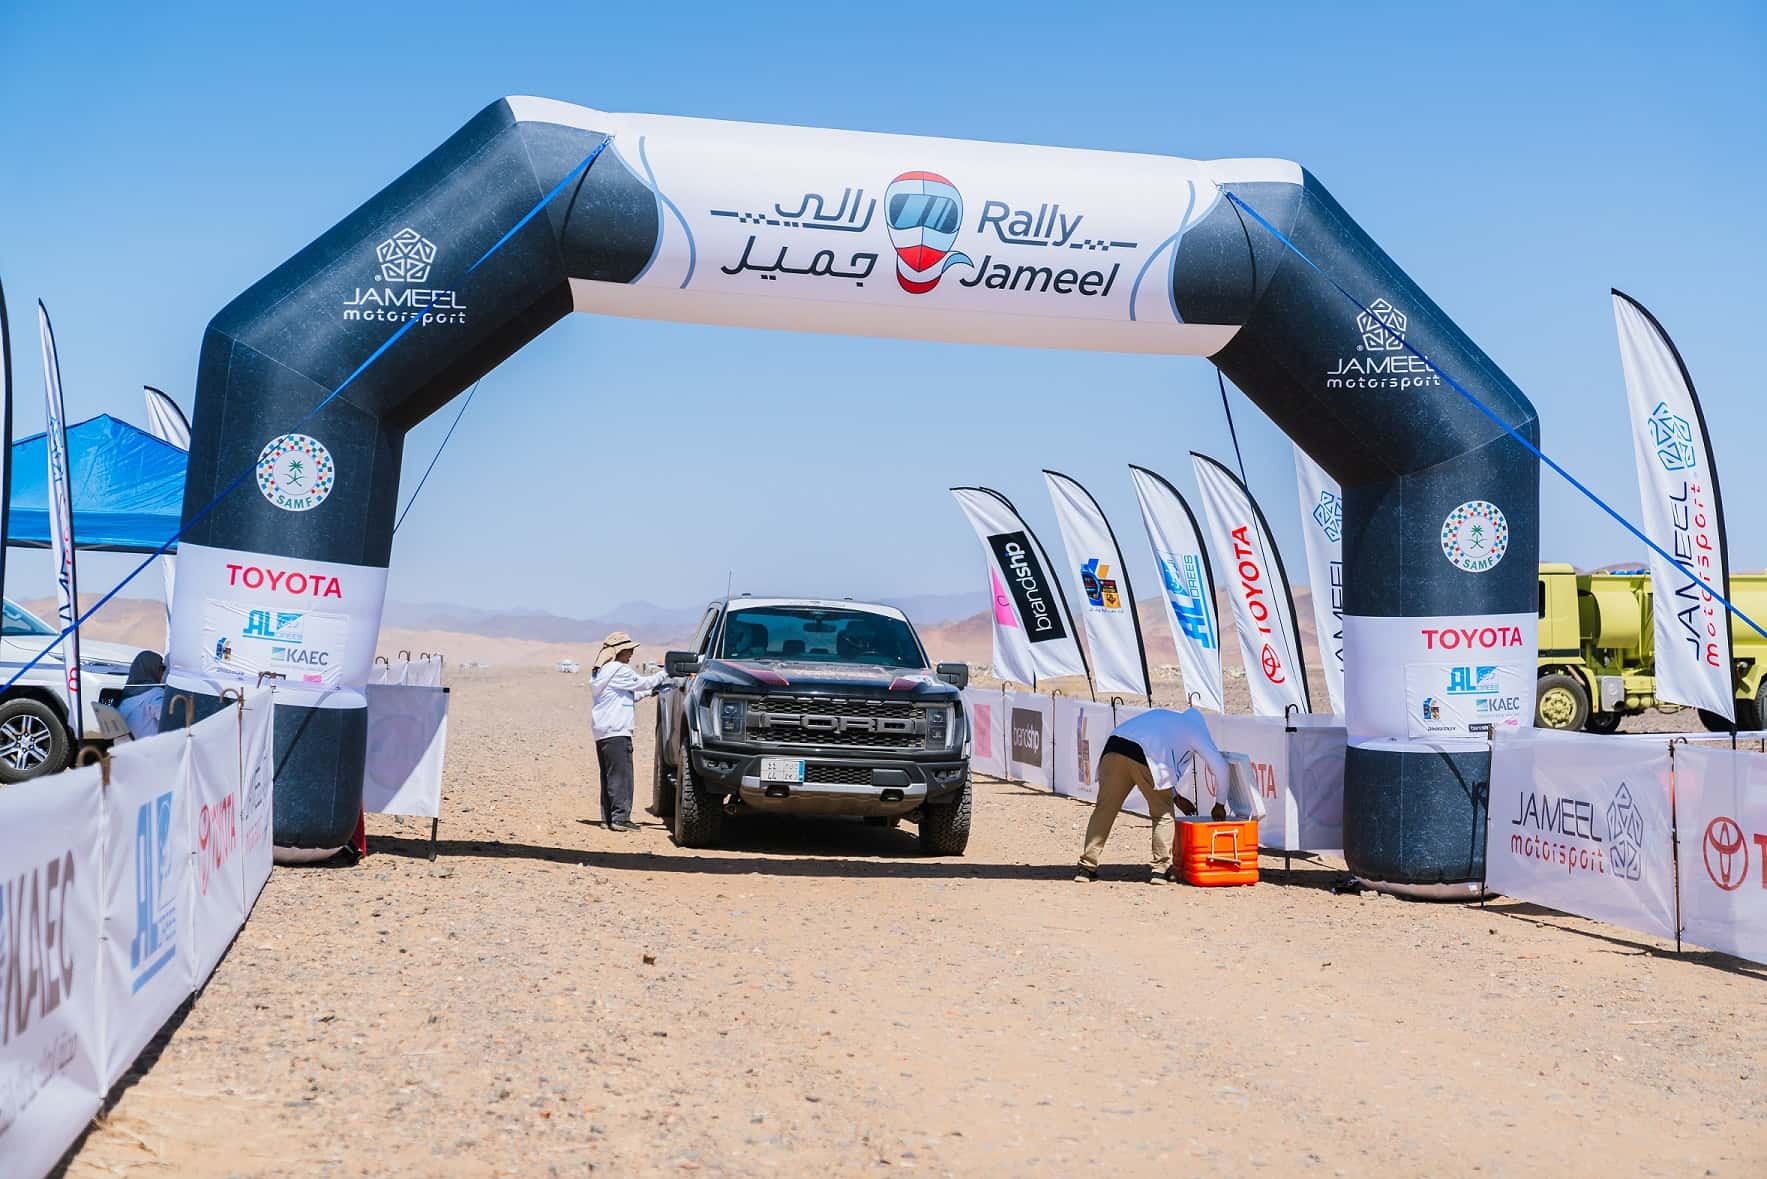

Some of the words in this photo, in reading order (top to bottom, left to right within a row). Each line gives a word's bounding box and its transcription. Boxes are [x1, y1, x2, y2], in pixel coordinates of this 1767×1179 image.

[977, 200, 1083, 248] Rally
[720, 235, 879, 288] جميل
[958, 255, 1121, 297] Jameel
[343, 288, 467, 309] JAMEEL
[1327, 355, 1437, 375] JAMEEL
[1327, 374, 1441, 391] motorsport
[275, 493, 314, 511] SAMF
[1462, 557, 1495, 571] SAMF
[226, 564, 343, 598] TOYOTA
[1421, 627, 1523, 648] TOYOTA
[286, 648, 329, 666] KAEC
[1489, 697, 1520, 712] KAEC
[758, 712, 915, 734] FORD
[1511, 791, 1602, 842] JAMEEL
[1510, 833, 1605, 875] motorsport
[2, 850, 76, 1045] KAEC
